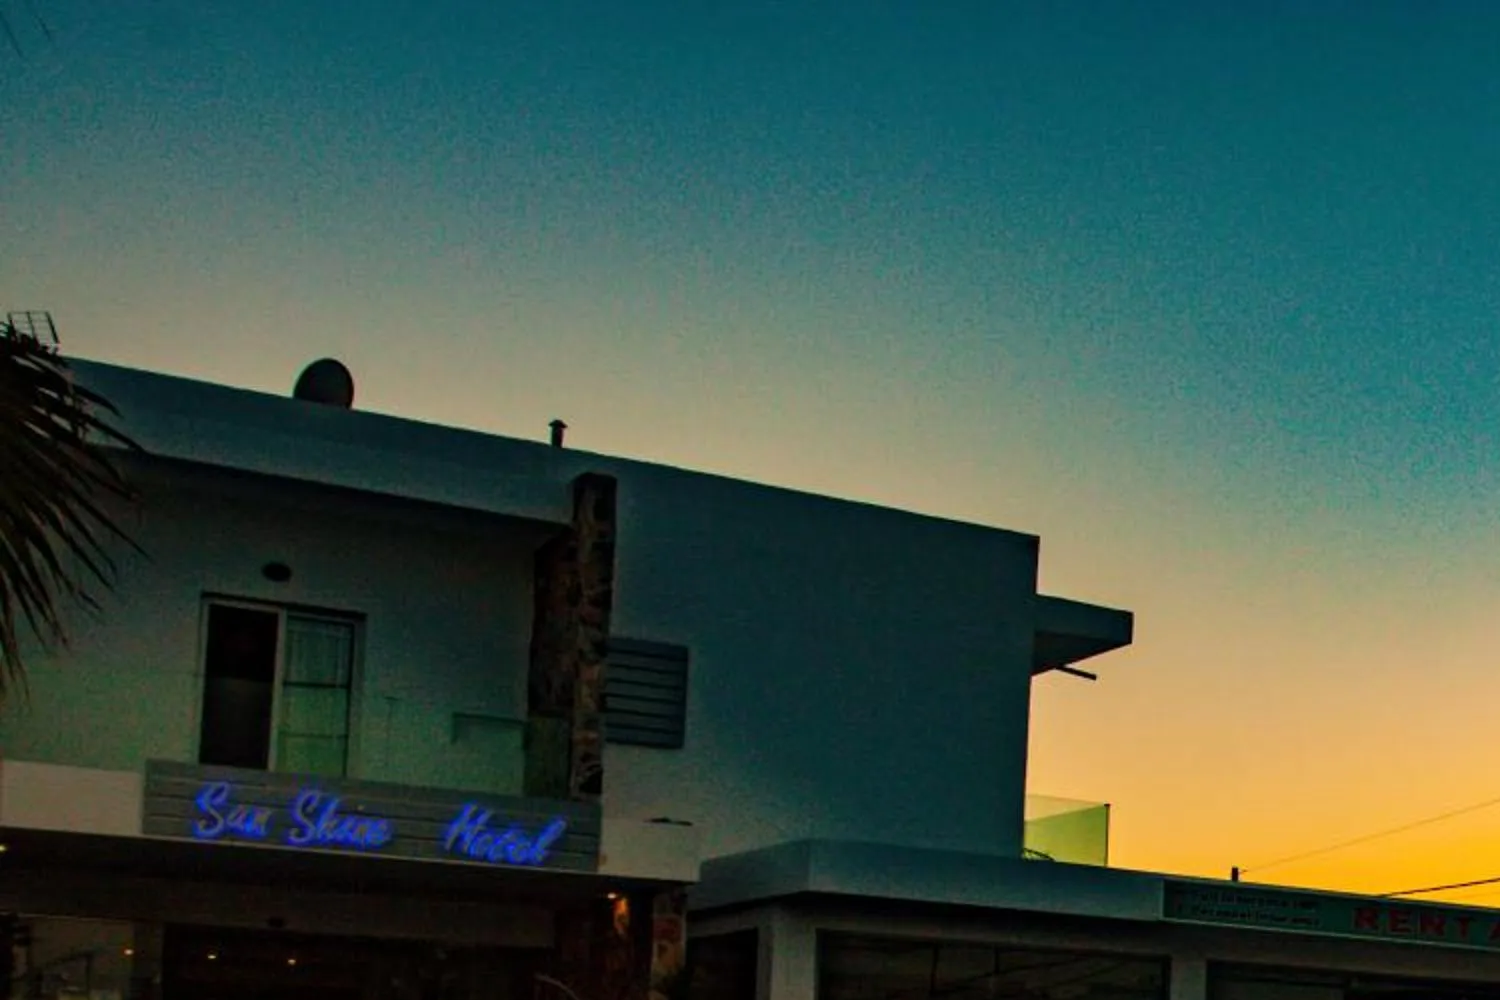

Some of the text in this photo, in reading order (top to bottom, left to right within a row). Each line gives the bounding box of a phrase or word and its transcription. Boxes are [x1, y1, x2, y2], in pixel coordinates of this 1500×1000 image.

[195, 781, 566, 865] Sun Shine Hotel
[1354, 906, 1472, 939] RENT
